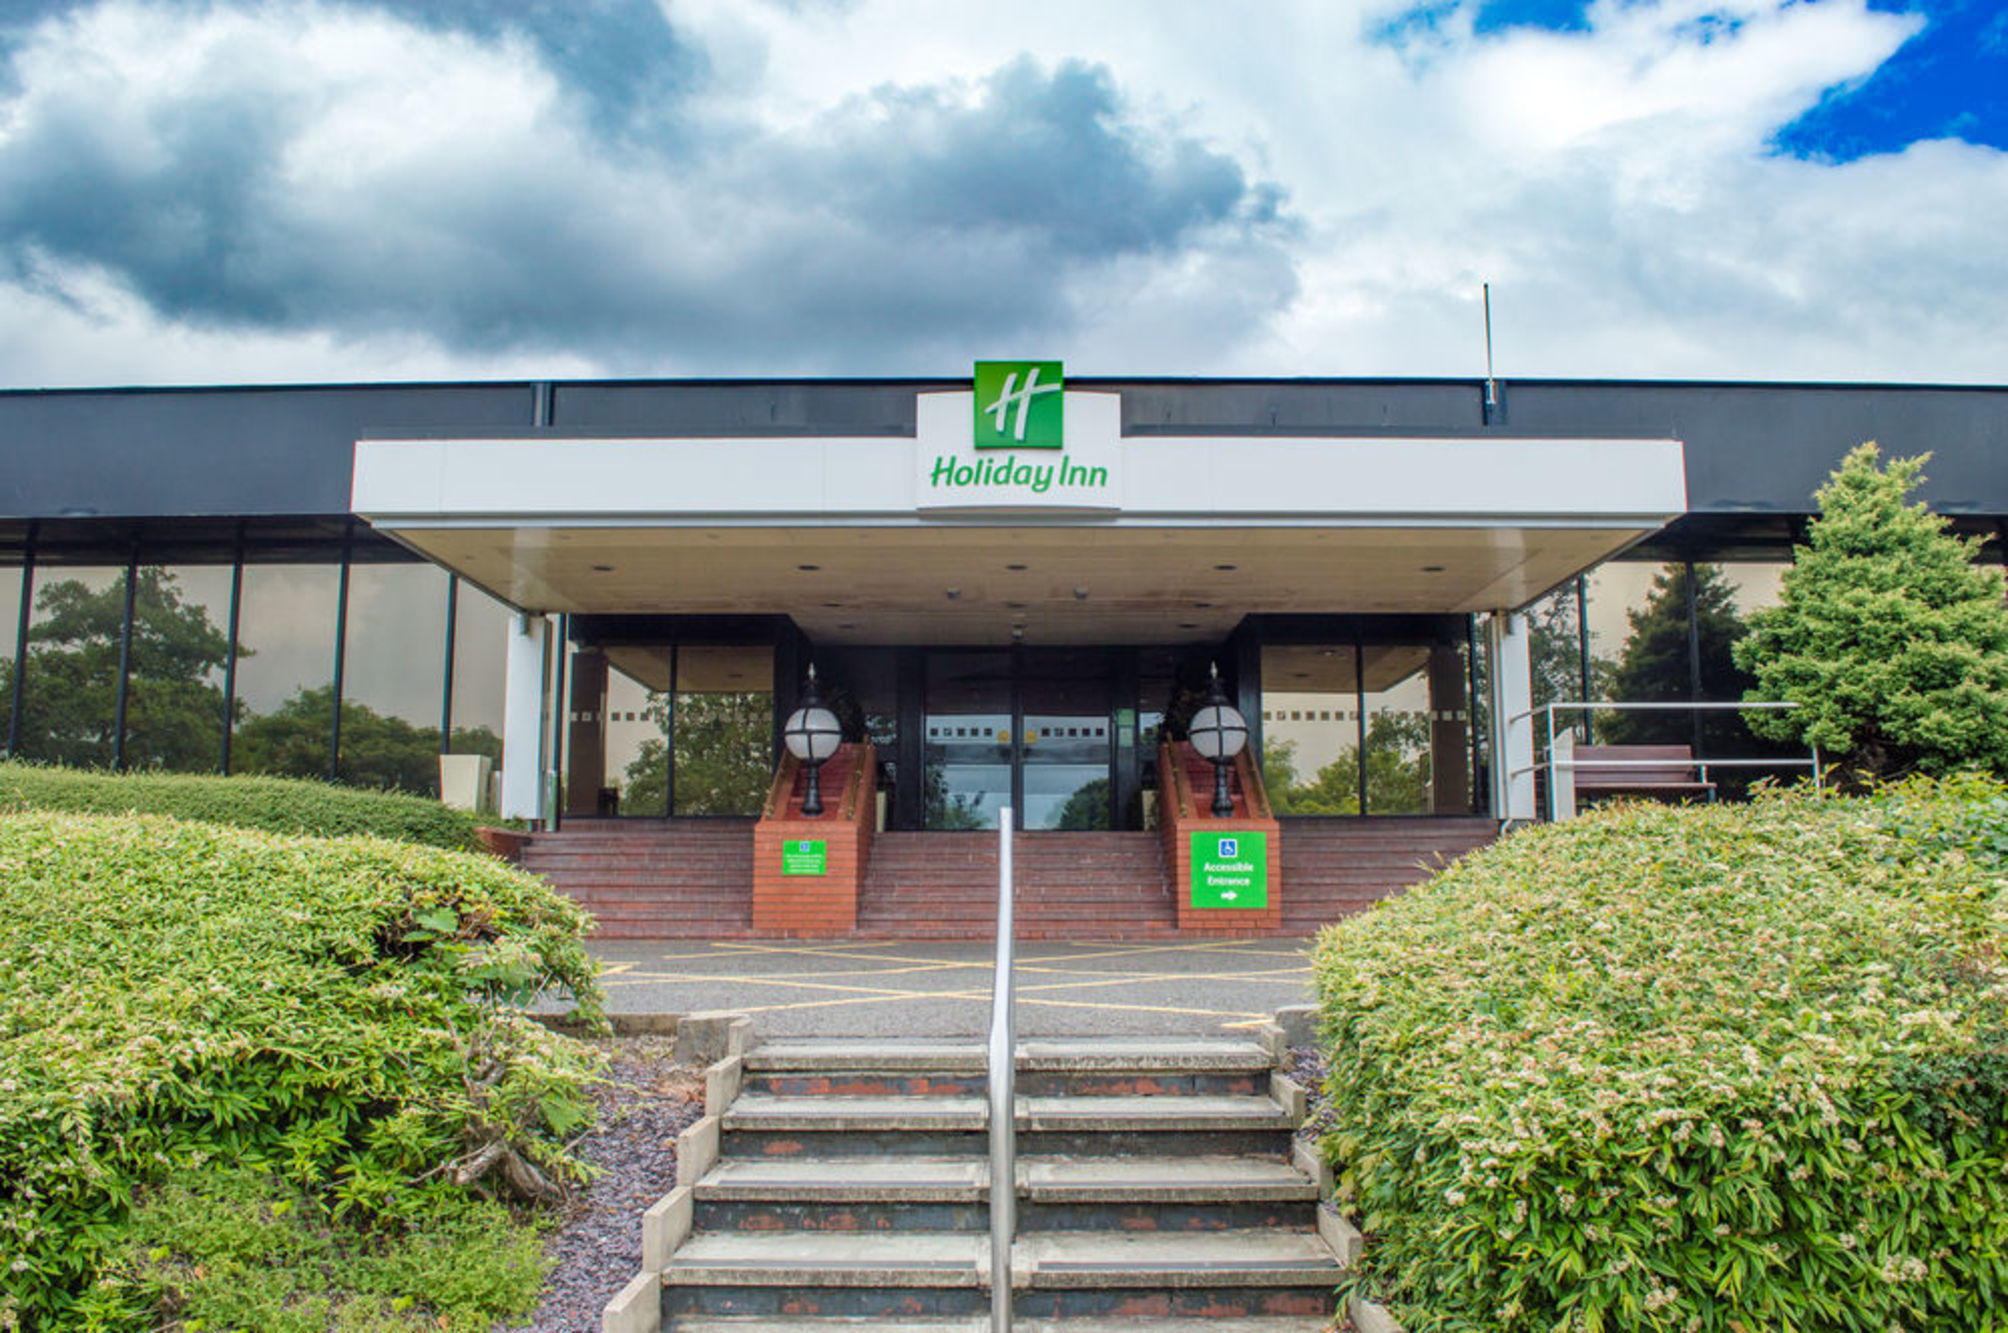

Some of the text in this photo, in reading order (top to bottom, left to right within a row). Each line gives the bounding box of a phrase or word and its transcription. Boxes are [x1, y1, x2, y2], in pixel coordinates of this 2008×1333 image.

[984, 368, 1060, 441] H
[931, 455, 1108, 493] Holiday Inn
[1204, 861, 1254, 872] Accessible
[1207, 876, 1250, 886] Entrance
